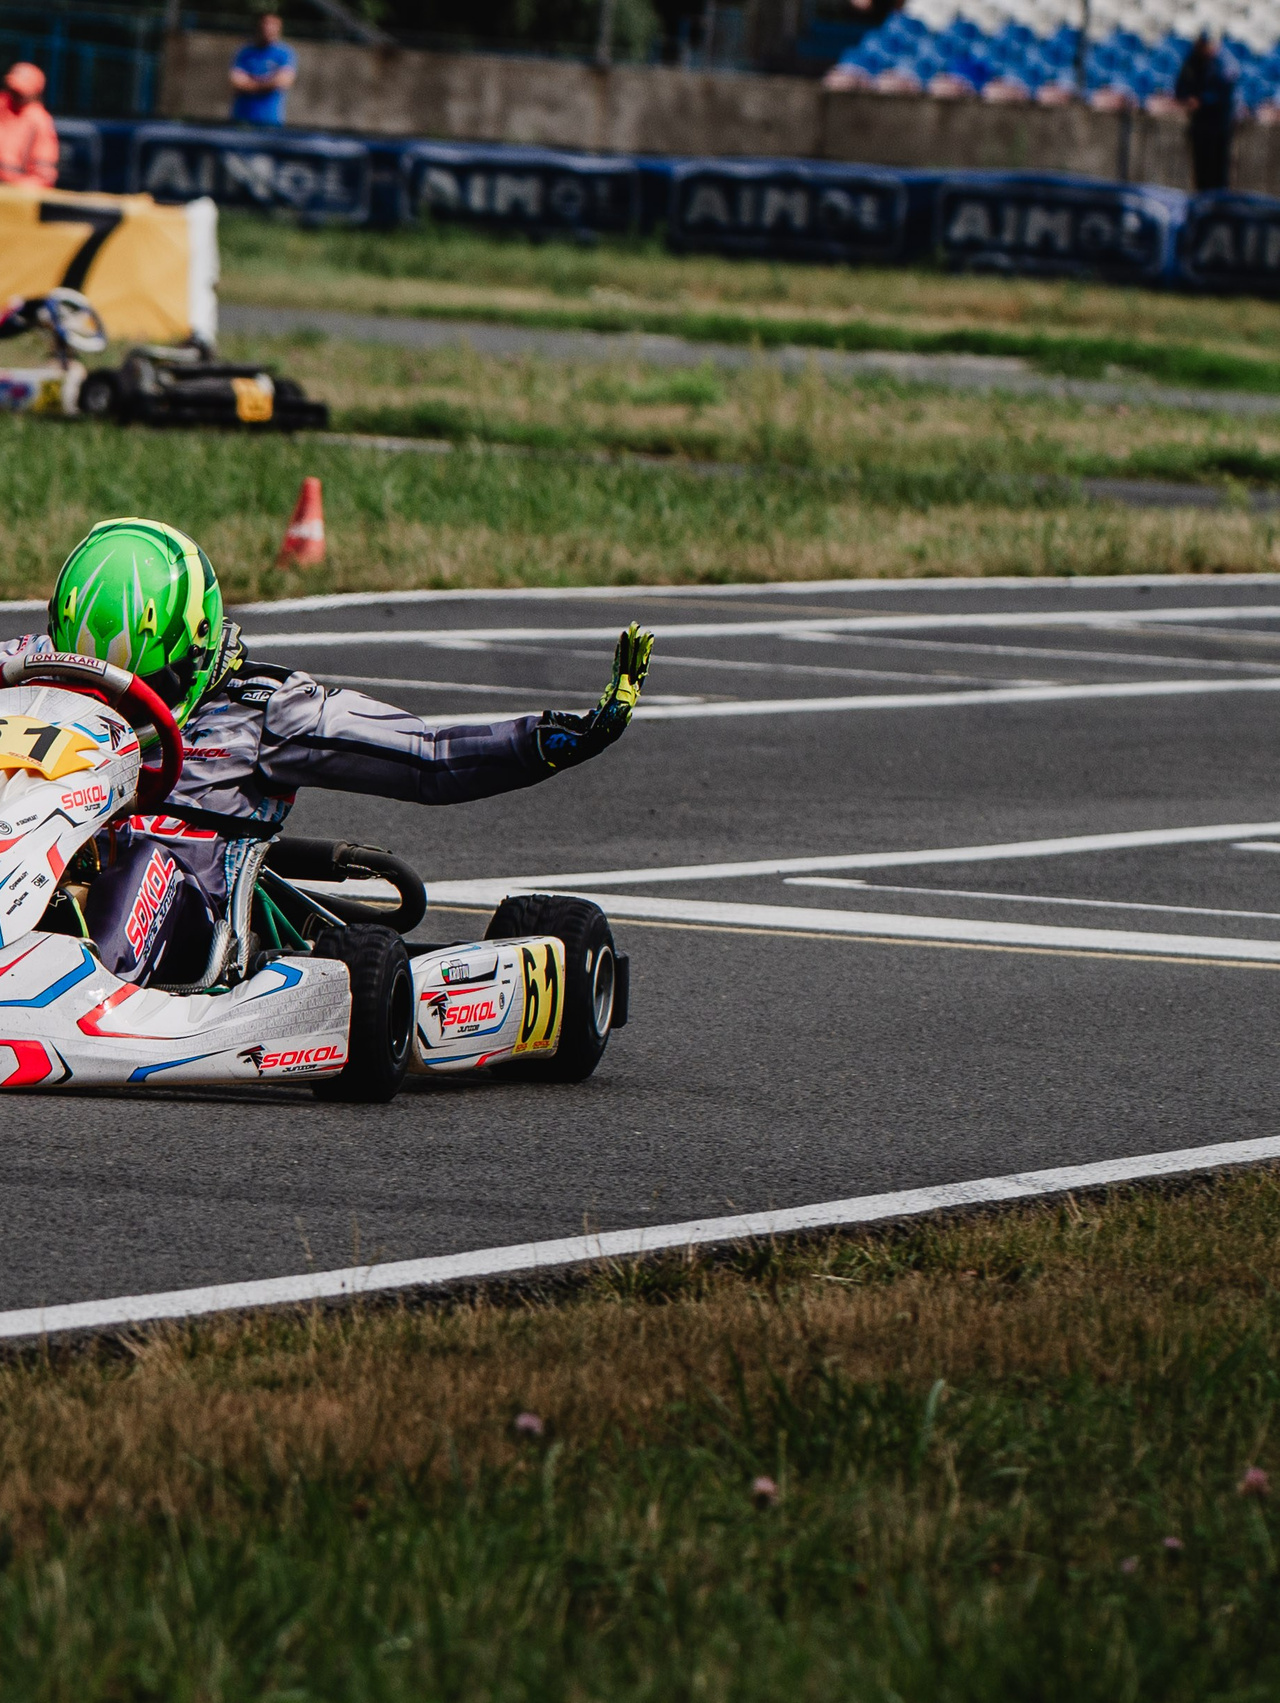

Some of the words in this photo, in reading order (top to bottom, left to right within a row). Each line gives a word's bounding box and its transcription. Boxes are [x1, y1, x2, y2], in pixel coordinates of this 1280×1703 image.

[39, 203, 125, 291] 7
[183, 747, 231, 758] OKOL
[61, 785, 108, 810] SOKOL
[125, 848, 176, 963] SOKOL
[521, 944, 558, 1043] 61
[443, 1001, 497, 1027] SOKOL
[259, 1046, 344, 1069] SOKOL
